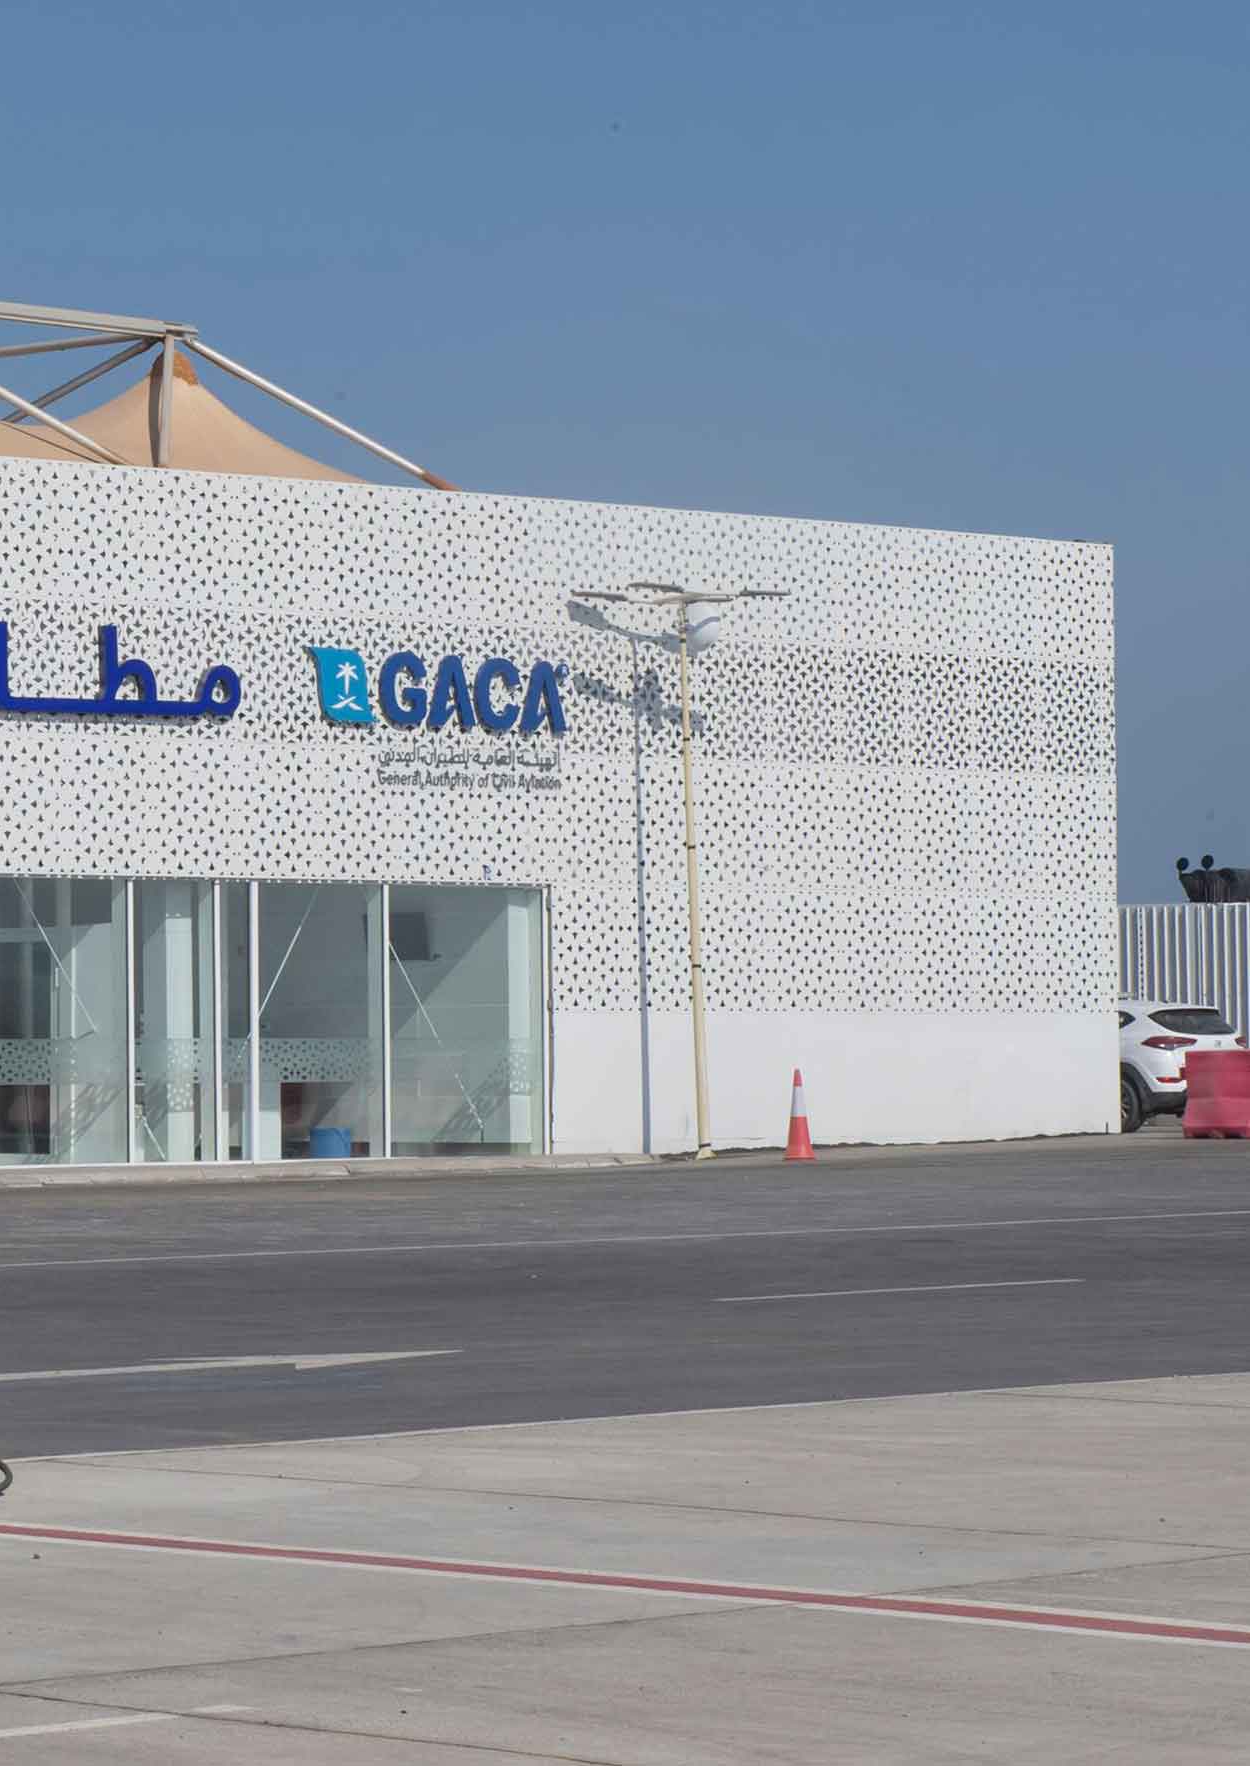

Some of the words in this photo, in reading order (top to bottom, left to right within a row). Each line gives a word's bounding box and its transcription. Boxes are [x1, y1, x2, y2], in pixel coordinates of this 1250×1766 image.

[378, 770, 421, 786] General
[426, 771, 474, 790] Authority
[478, 774, 490, 786] of
[494, 774, 515, 788] Civil
[518, 774, 561, 790] Aviation
